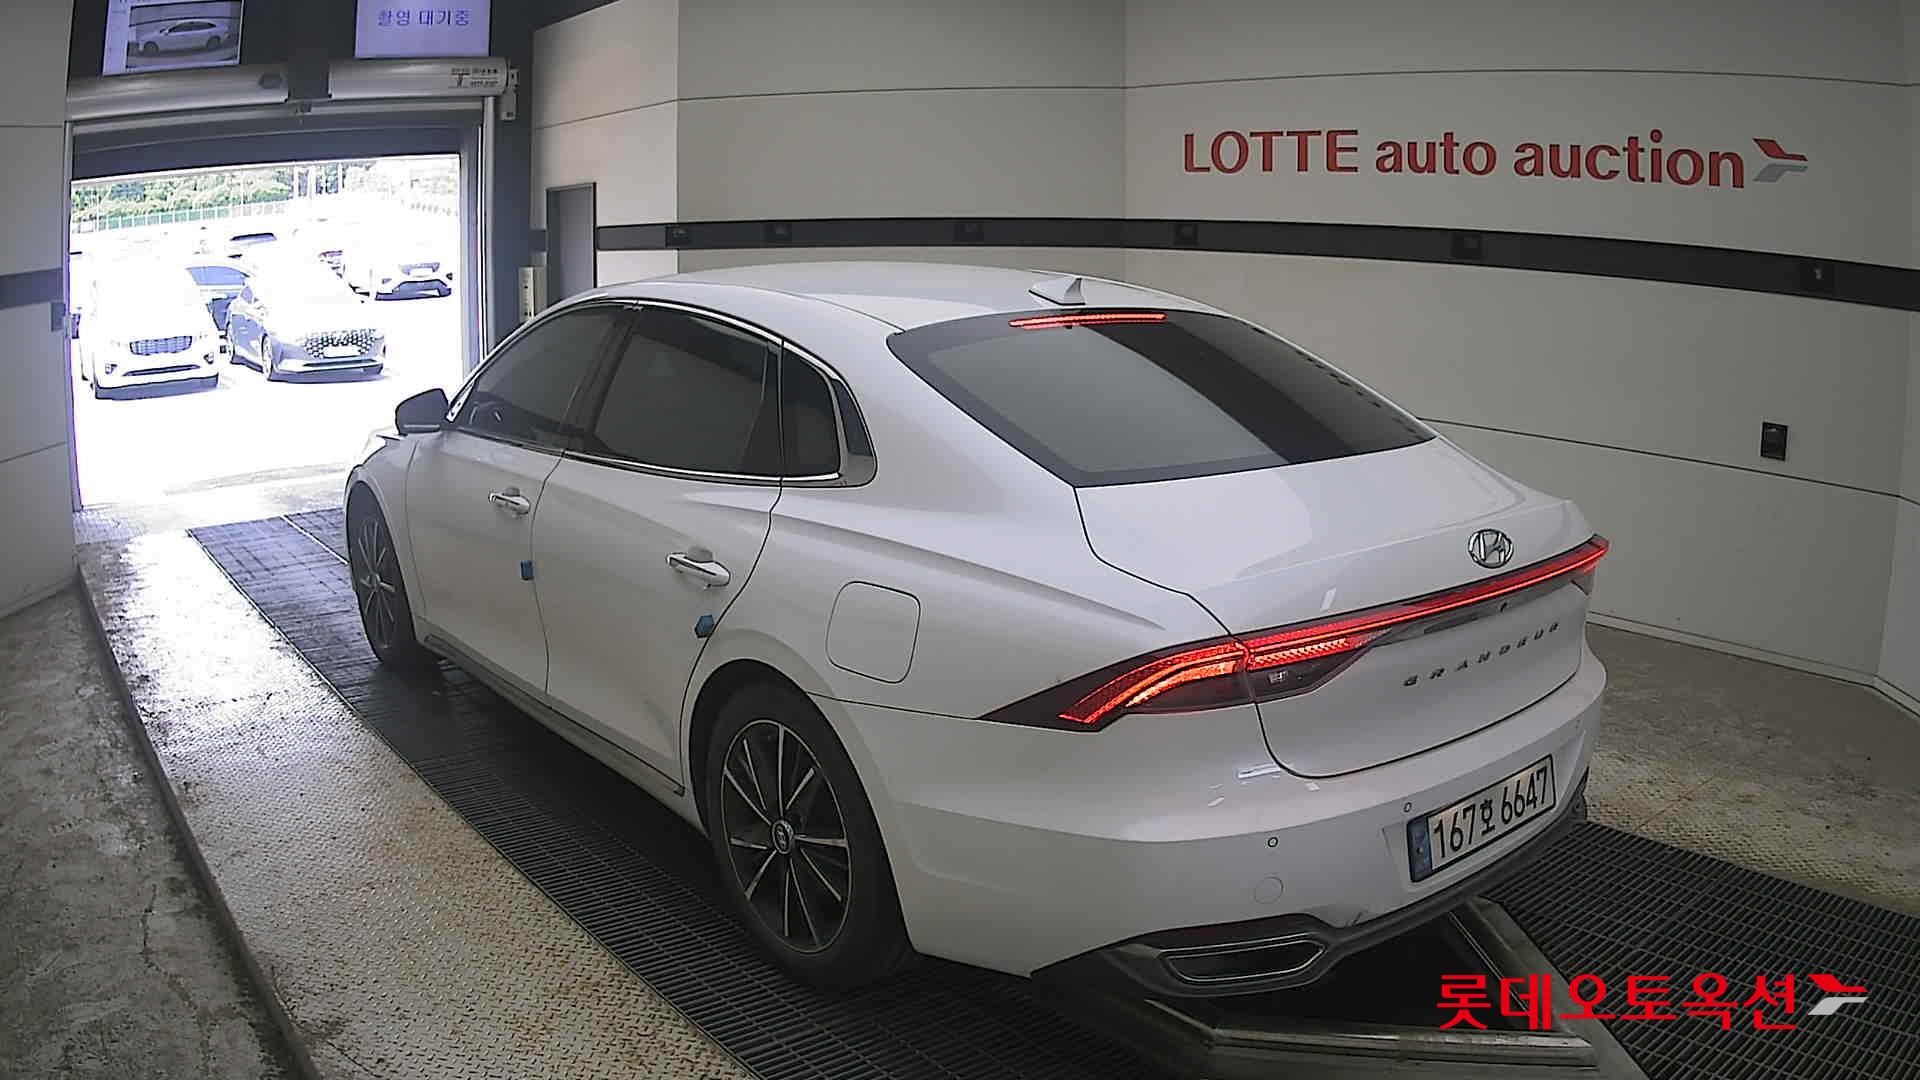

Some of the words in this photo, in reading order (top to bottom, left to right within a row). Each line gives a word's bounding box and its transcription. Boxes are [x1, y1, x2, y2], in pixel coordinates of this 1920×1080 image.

[419, 9, 470, 26] 대기중
[1184, 130, 1359, 174] LOTTE
[1376, 132, 1497, 176] auto
[1513, 129, 1746, 188] auction
[1403, 622, 1558, 687] GRANDEUR
[1501, 765, 1547, 825] 6647
